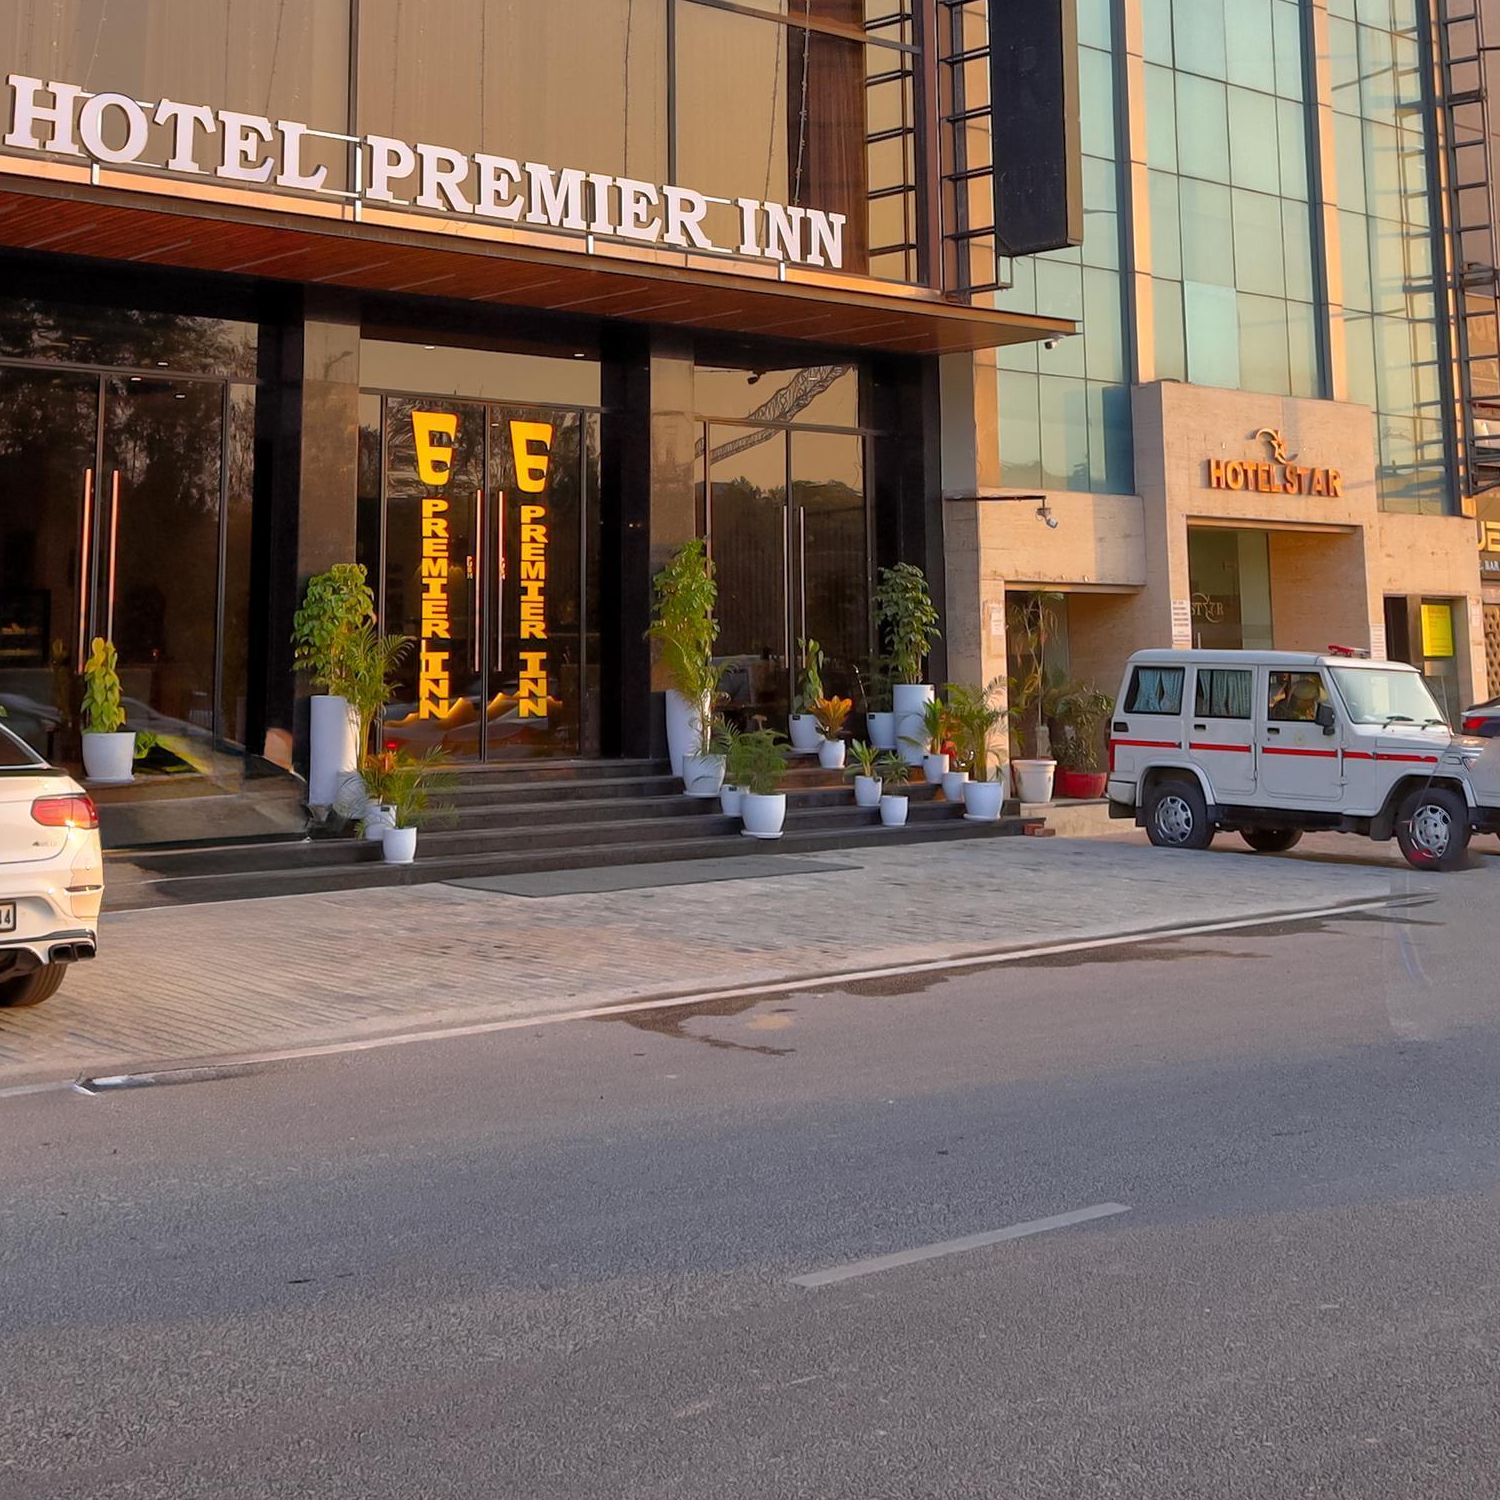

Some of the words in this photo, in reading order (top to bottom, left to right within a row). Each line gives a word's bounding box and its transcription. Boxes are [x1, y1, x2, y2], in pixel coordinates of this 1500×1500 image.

[3, 73, 328, 190] HOTEL
[362, 134, 712, 250] PREMIER
[735, 197, 846, 268] INN
[1209, 459, 1281, 493] HOTEL
[1285, 466, 1344, 497] STAR
[421, 498, 451, 639] PREMIER
[520, 505, 548, 639] PREMIER
[1484, 560, 1500, 571] BAR
[419, 651, 450, 720] INN
[519, 651, 547, 718] INN
